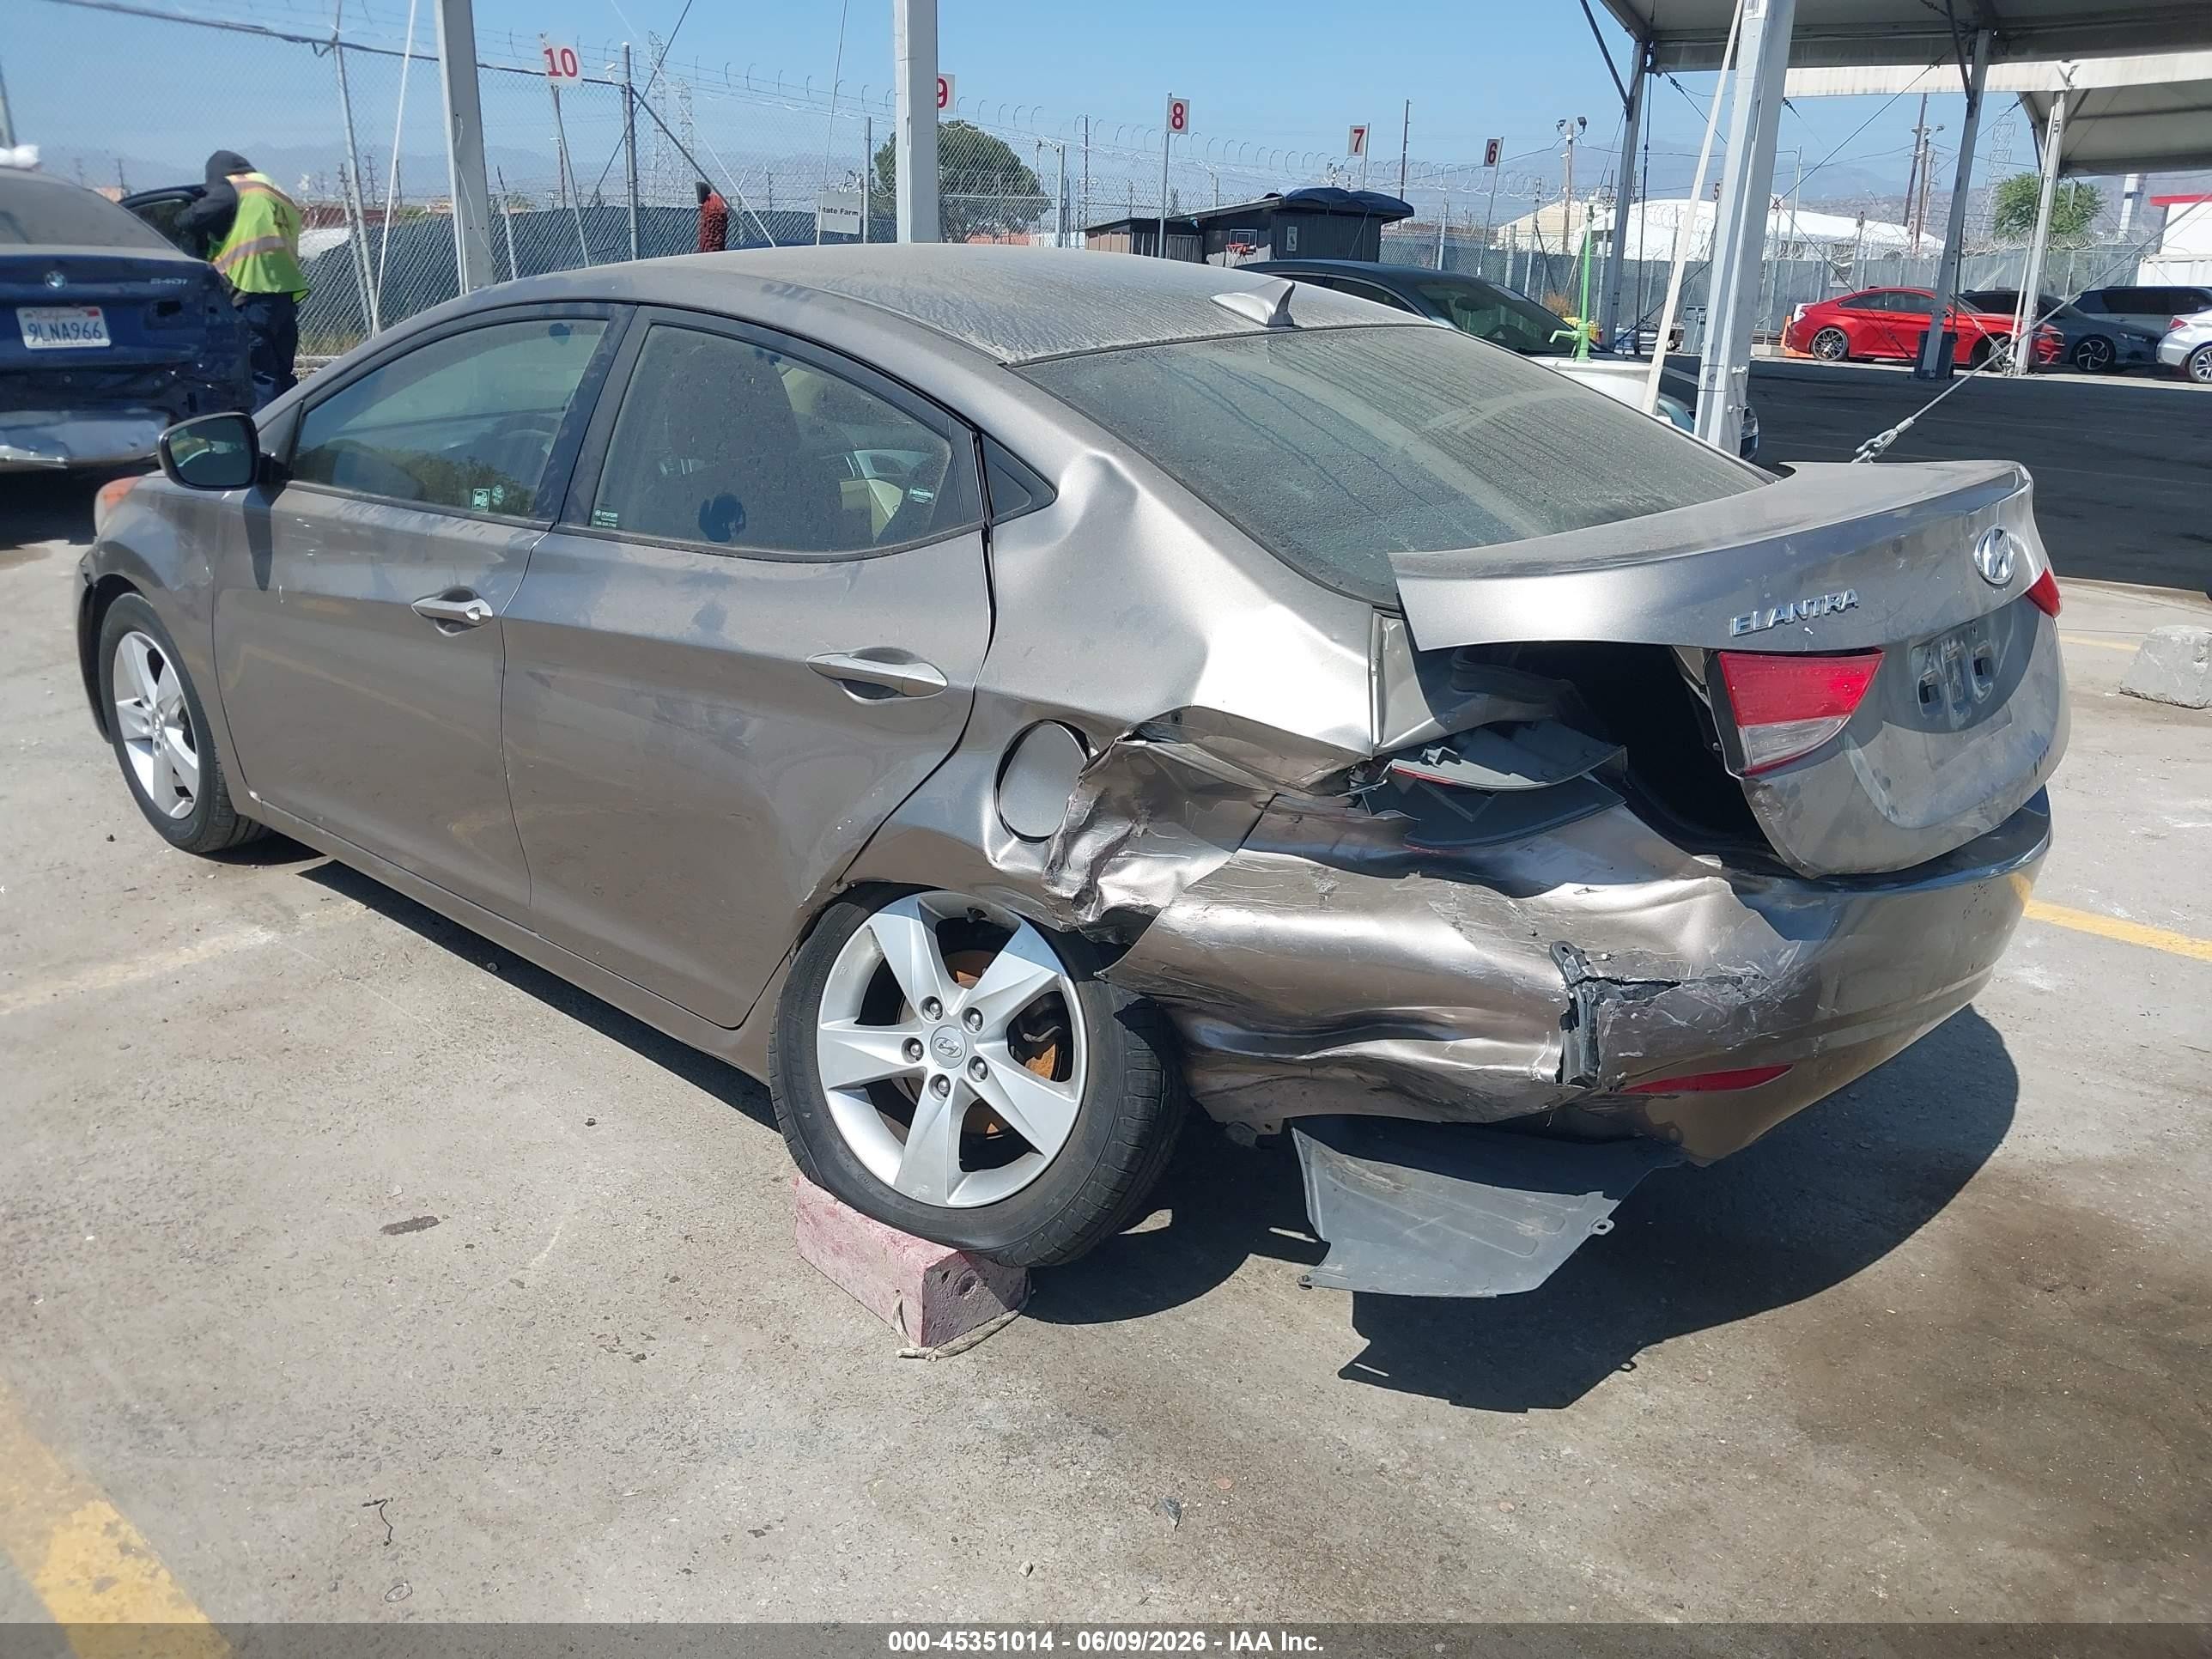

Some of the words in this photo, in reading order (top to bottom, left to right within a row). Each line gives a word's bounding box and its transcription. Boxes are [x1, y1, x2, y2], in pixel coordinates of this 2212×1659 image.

[544, 48, 577, 77] 10
[938, 78, 948, 108] 9
[1172, 102, 1184, 130] 8
[1353, 129, 1364, 153] 7
[1488, 143, 1497, 164] 6
[1713, 182, 1720, 200] 5
[840, 208, 859, 216] Farm
[1858, 210, 1864, 226] 3
[1909, 221, 1914, 234] 2
[27, 321, 103, 343] 9LNA966
[1729, 588, 1860, 637] ELANTRA
